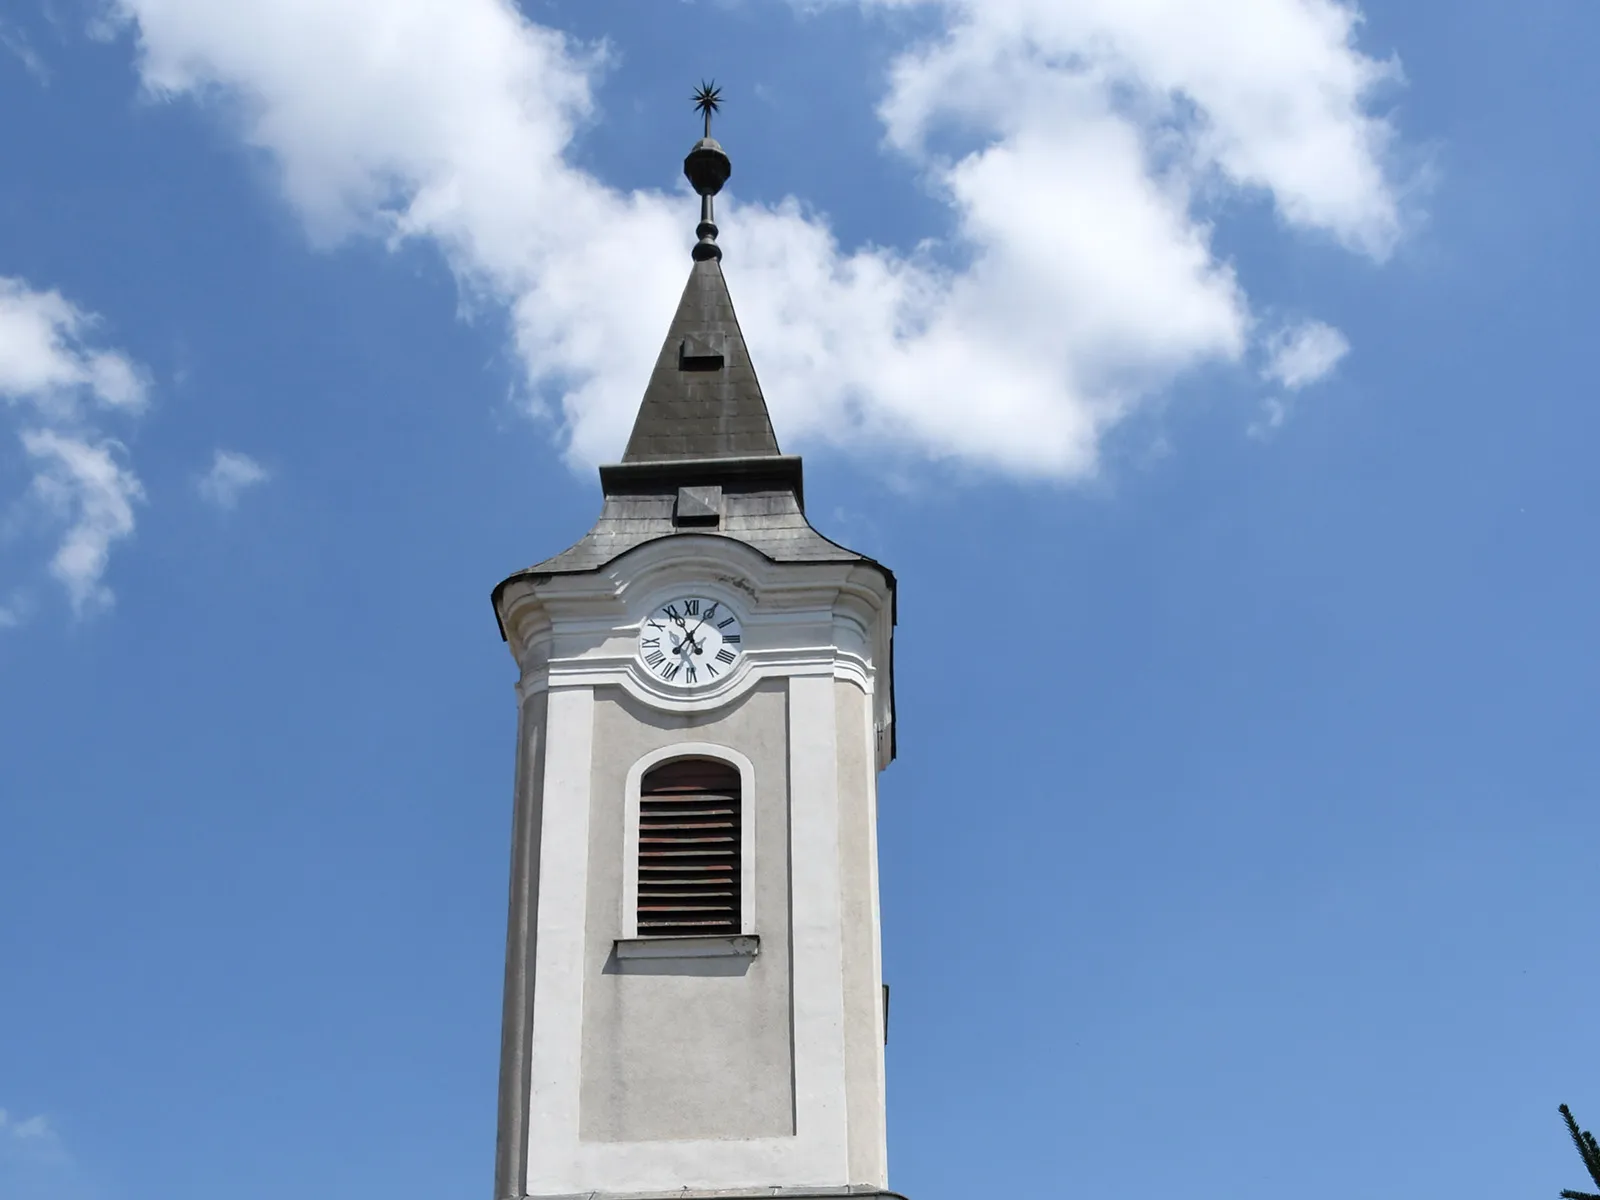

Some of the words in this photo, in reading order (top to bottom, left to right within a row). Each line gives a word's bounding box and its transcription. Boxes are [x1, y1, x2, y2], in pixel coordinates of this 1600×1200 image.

[684, 600, 699, 616] XII
[647, 619, 666, 632] X
[717, 617, 735, 629] II
[642, 637, 660, 648] IX
[722, 635, 740, 644] III
[644, 649, 667, 670] VIII
[715, 648, 736, 665] IIII
[660, 662, 680, 681] VII
[686, 667, 698, 683] VI
[706, 663, 720, 678] V
